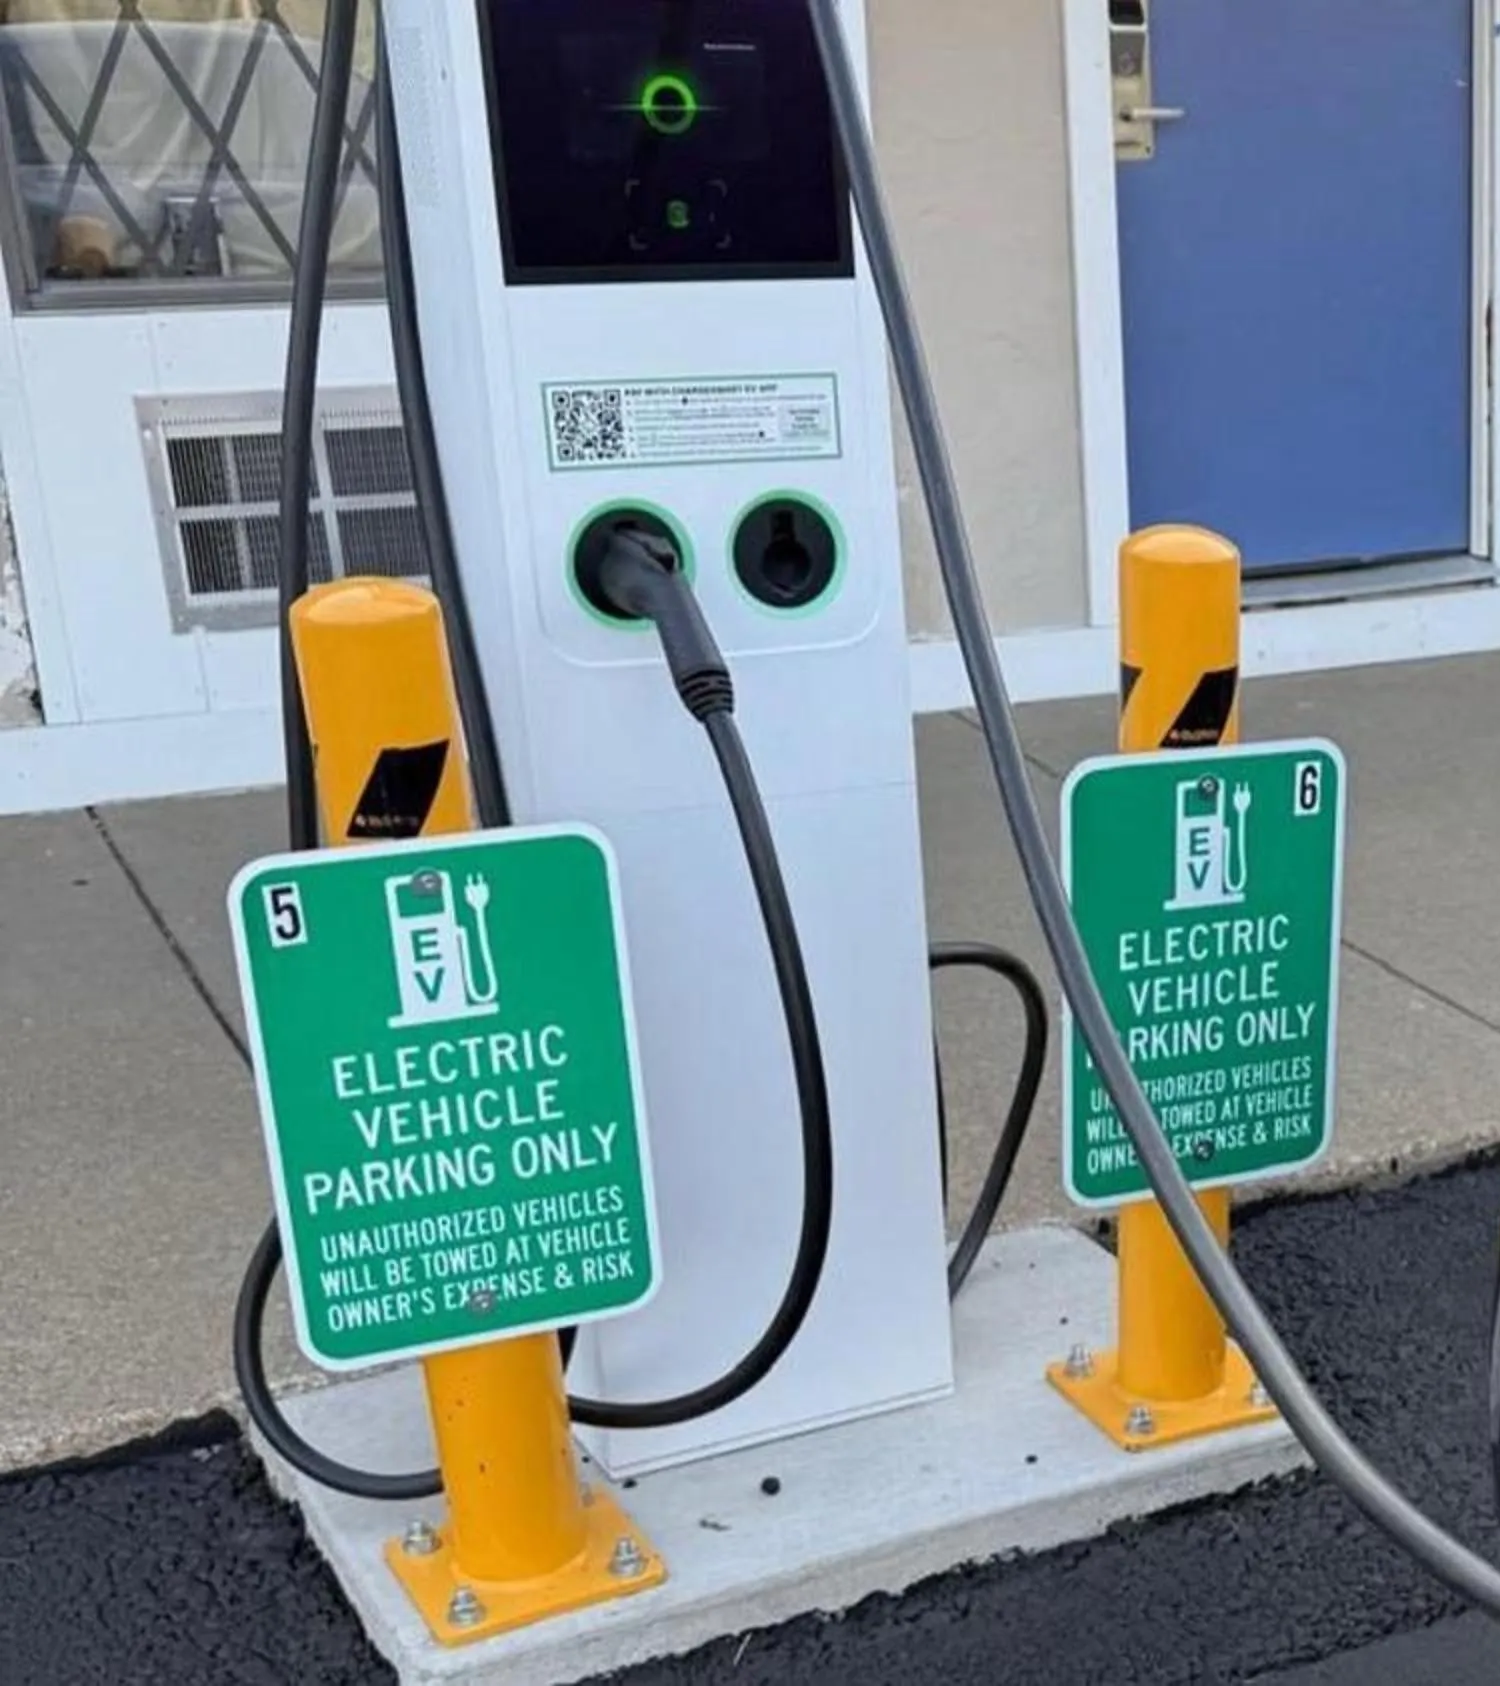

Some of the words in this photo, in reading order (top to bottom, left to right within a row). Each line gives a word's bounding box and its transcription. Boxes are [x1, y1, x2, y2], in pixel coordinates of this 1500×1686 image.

[1300, 765, 1318, 811] 6
[271, 886, 301, 941] 5
[1119, 914, 1289, 971] ELECTRIC
[1129, 962, 1279, 1017] VEHICLE
[332, 1024, 569, 1099] ELECTRIC
[1086, 1016, 1224, 1069] RKING
[1236, 1002, 1315, 1048] ONLY
[353, 1079, 565, 1150] VEHICLE
[1091, 1068, 1226, 1113] UTHORIZED
[1231, 1056, 1312, 1089] VEHICLES
[1160, 1101, 1216, 1131] TOWED
[1220, 1094, 1241, 1121] AT
[1244, 1084, 1312, 1117] VEHICLE
[304, 1143, 496, 1216] PARKING
[511, 1121, 619, 1180] ONLY
[1087, 1143, 1138, 1175] OWNE
[1252, 1120, 1268, 1144] &
[1274, 1113, 1312, 1141] RISK
[321, 1205, 505, 1263] UNAUTHORIZED
[512, 1185, 624, 1227] VEHICLES
[320, 1262, 378, 1299] WILL
[386, 1255, 416, 1286] BE
[422, 1240, 498, 1281] TOWED
[505, 1233, 532, 1265] AT
[536, 1219, 631, 1258] VEHICLE
[327, 1286, 436, 1332] OWNER'S
[553, 1261, 575, 1289] &
[582, 1251, 634, 1286] RISK
